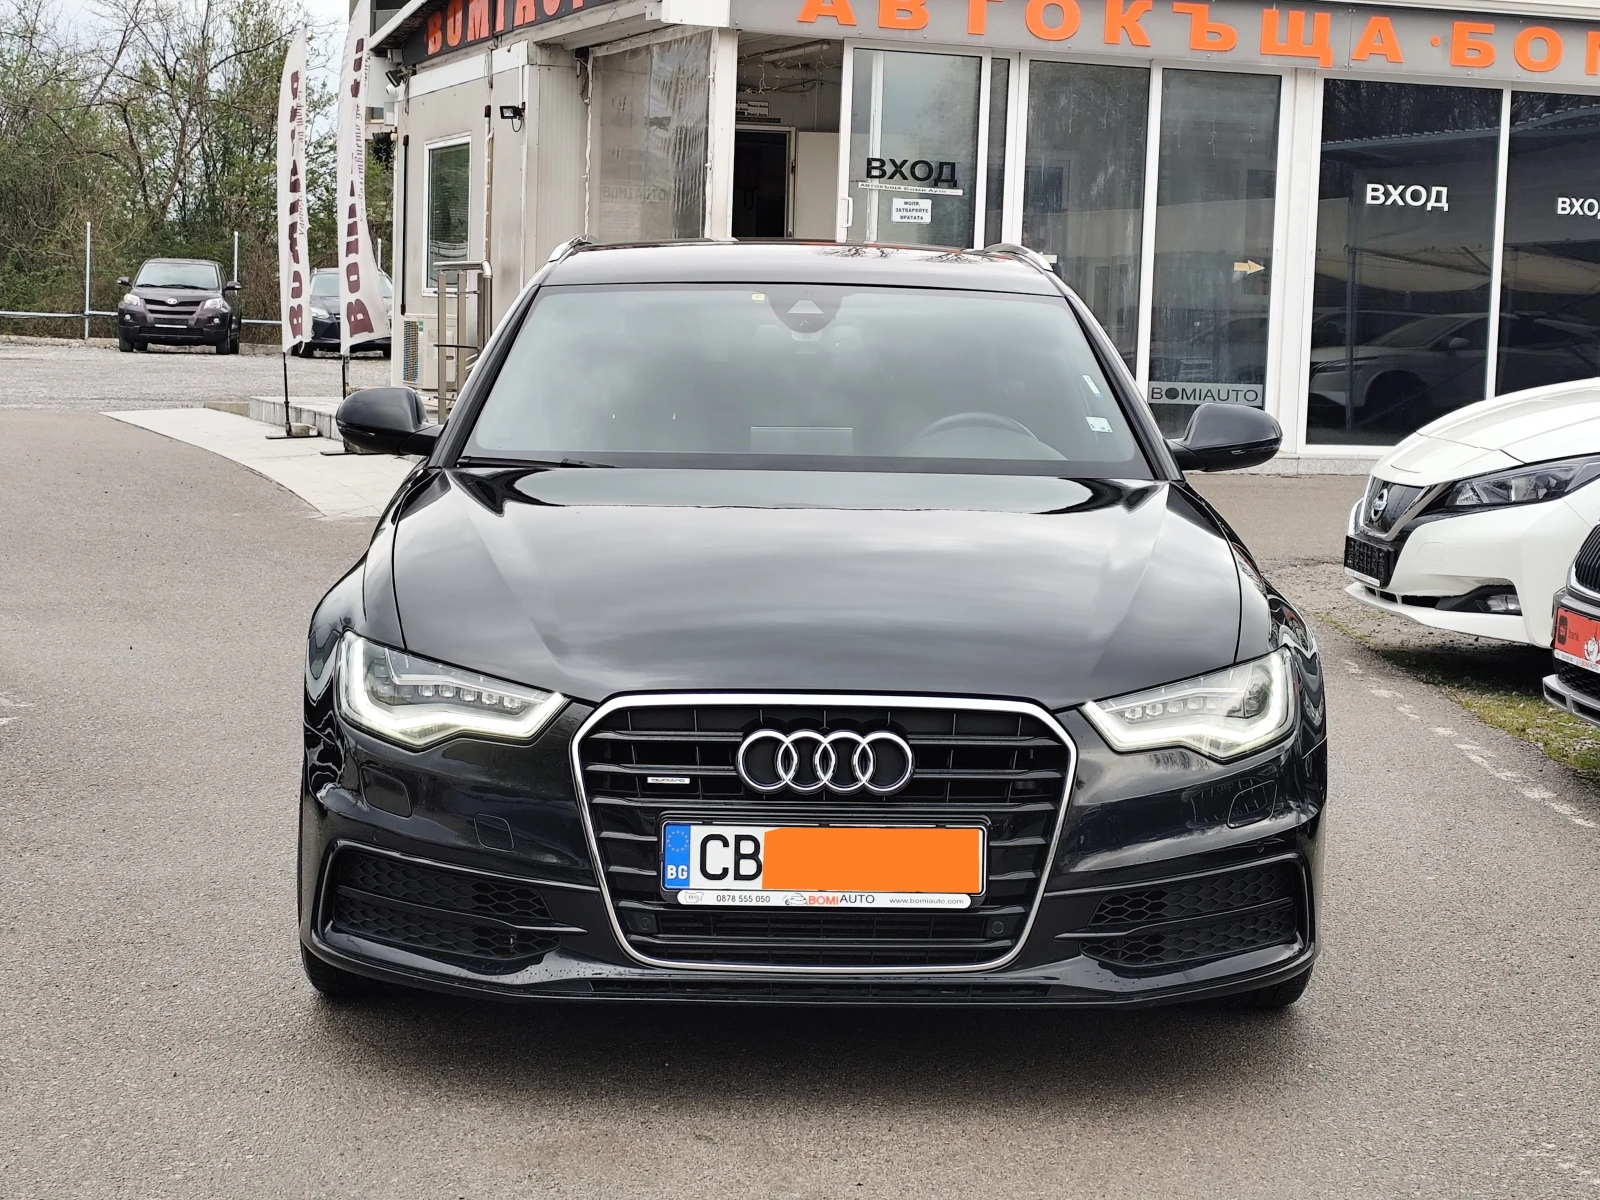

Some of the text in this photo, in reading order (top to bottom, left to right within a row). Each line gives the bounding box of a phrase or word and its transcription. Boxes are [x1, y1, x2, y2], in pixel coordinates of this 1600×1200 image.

[1449, 20, 1600, 76] БО
[866, 157, 957, 187] ВХОД
[1365, 183, 1449, 212] ВХОД
[1556, 197, 1600, 220] ВХО
[1151, 387, 1259, 402] BOMIAUTO
[667, 864, 688, 880] BG
[716, 894, 771, 903] 0878 555 050
[889, 897, 965, 905] www.bomiauto.com
